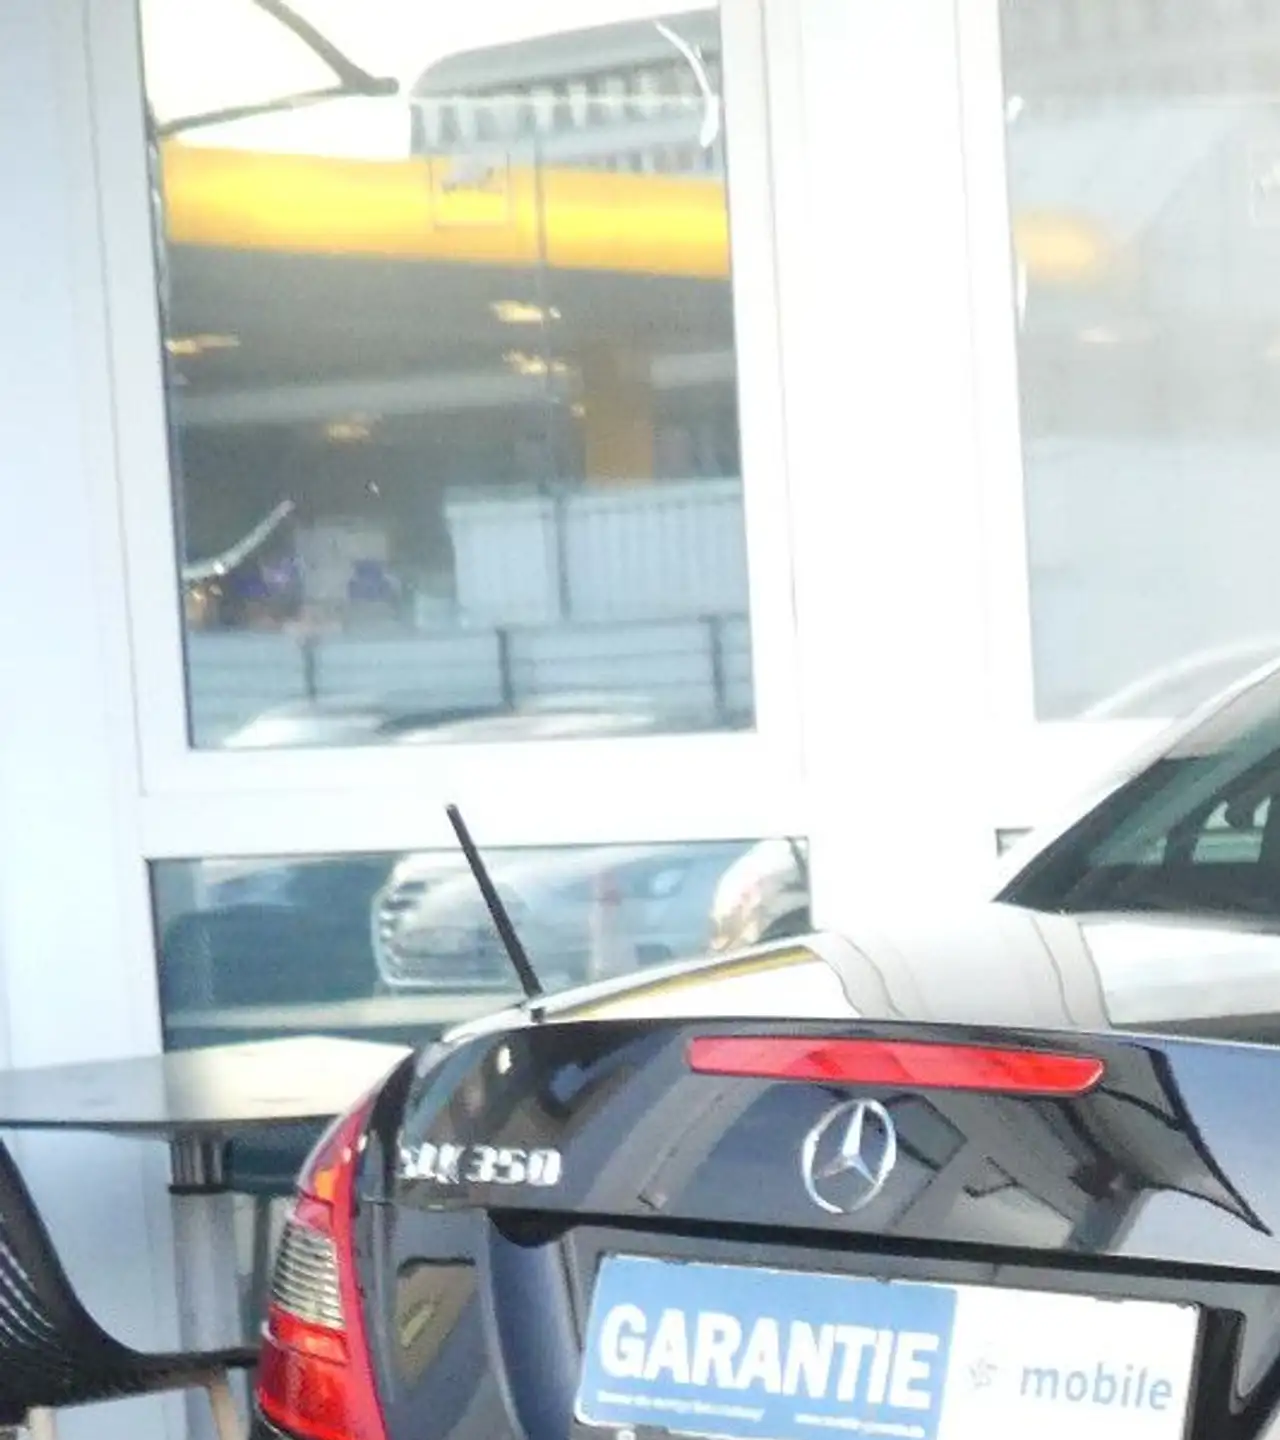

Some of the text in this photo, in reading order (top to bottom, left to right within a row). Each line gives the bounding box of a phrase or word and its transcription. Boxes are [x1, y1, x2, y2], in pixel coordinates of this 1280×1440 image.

[466, 1146, 561, 1186] 350
[600, 1303, 939, 1410] GARANTIE
[1020, 1362, 1173, 1410] mobile
